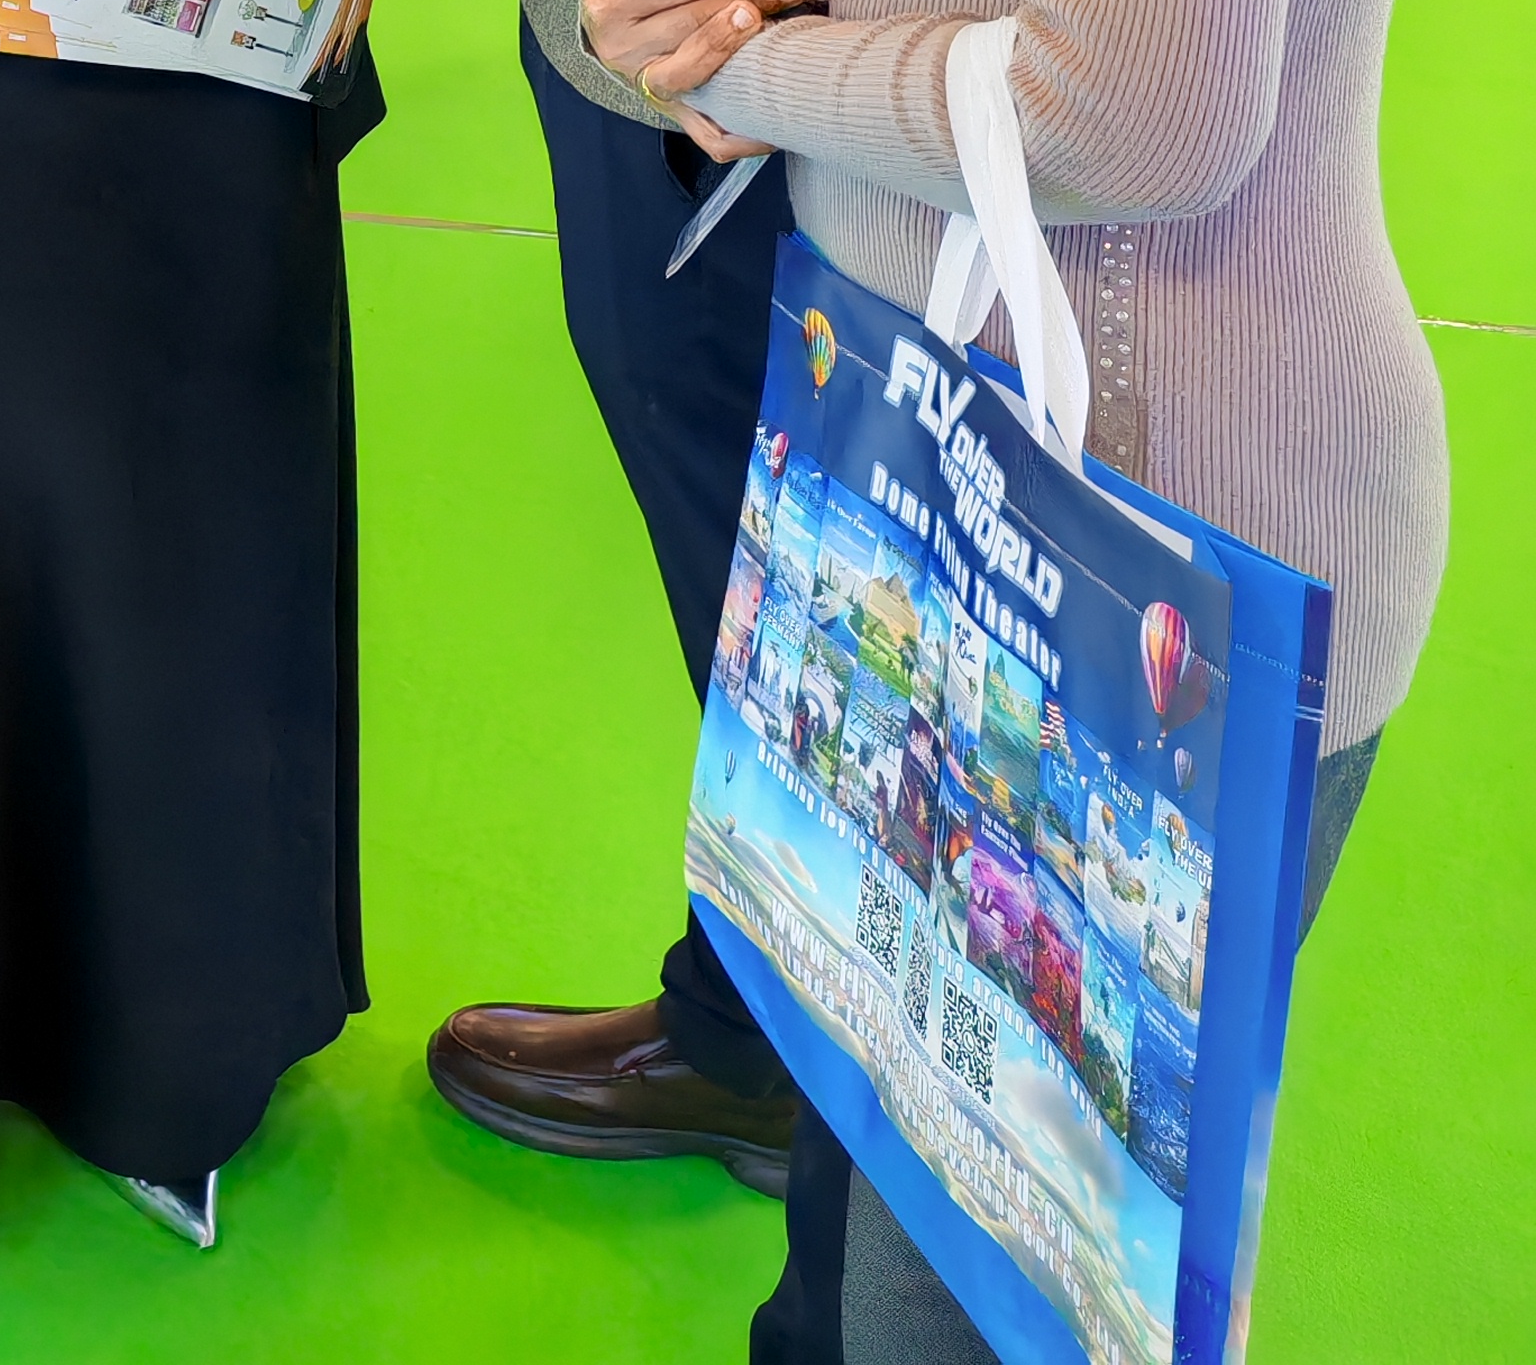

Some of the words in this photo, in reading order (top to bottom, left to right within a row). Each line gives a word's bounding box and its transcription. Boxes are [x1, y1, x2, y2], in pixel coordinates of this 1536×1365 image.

[883, 333, 977, 446] FLY
[950, 420, 1006, 511] OVER
[869, 459, 931, 542] Dome
[974, 572, 1062, 693] Theater
[953, 477, 1064, 619] WORLD
[1118, 781, 1144, 810] OVER
[1173, 851, 1198, 879] THE
[1180, 833, 1212, 870] OVER
